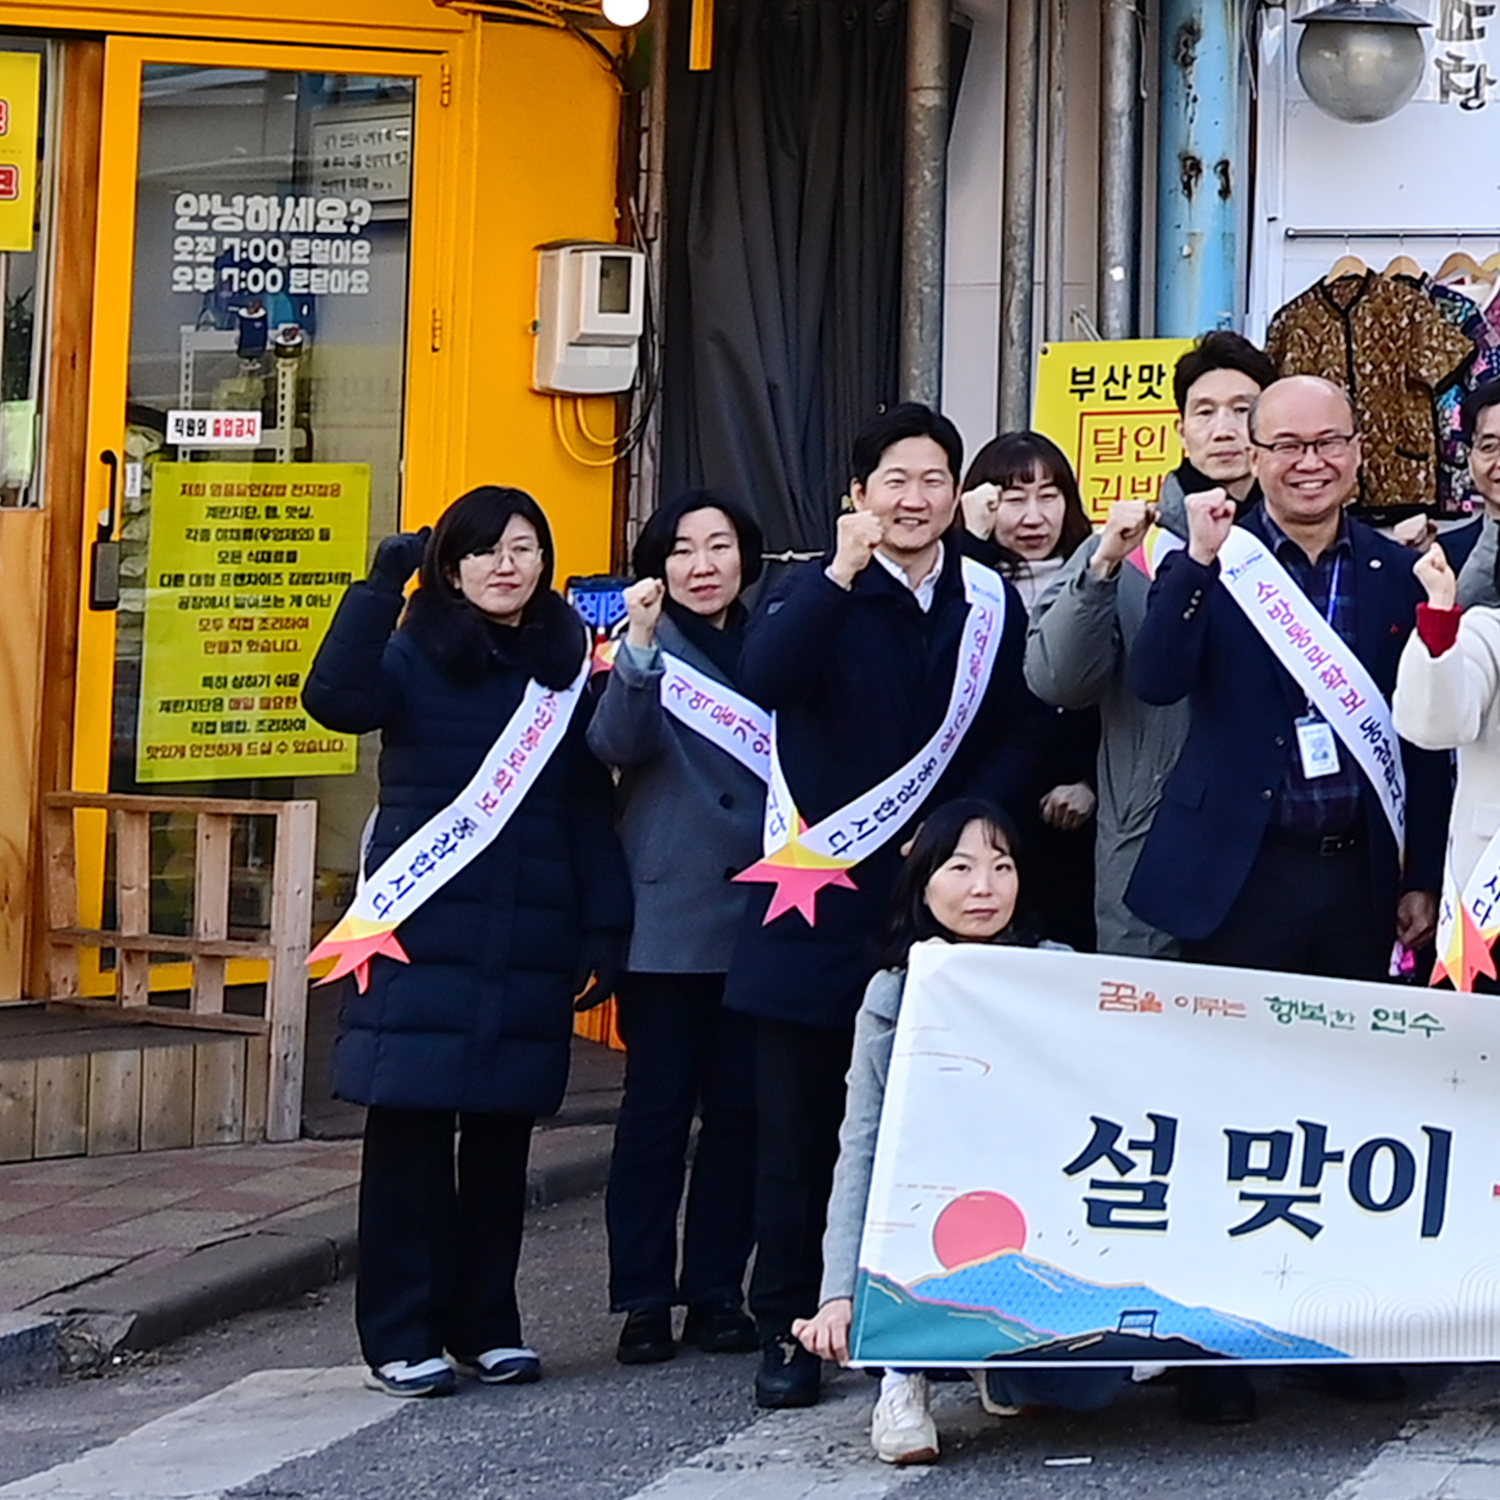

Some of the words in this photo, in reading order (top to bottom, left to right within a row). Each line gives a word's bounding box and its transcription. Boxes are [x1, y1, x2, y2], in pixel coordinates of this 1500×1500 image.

[174, 192, 372, 234] 안녕하세요?
[172, 235, 216, 263] 오전
[222, 238, 285, 263] 7:00
[172, 266, 215, 293] 오후
[221, 267, 284, 294] 7:00
[1093, 425, 1166, 464] 달인
[1253, 580, 1367, 717] 소방통로확보
[668, 674, 771, 756] 지역물가안
[826, 755, 939, 857] 동참합시다
[372, 815, 479, 920] 동참합시다
[1263, 993, 1357, 1031] 행복한
[1370, 1005, 1446, 1040] 연수
[1061, 1111, 1180, 1235] 설
[1221, 1118, 1454, 1242] 맞이
